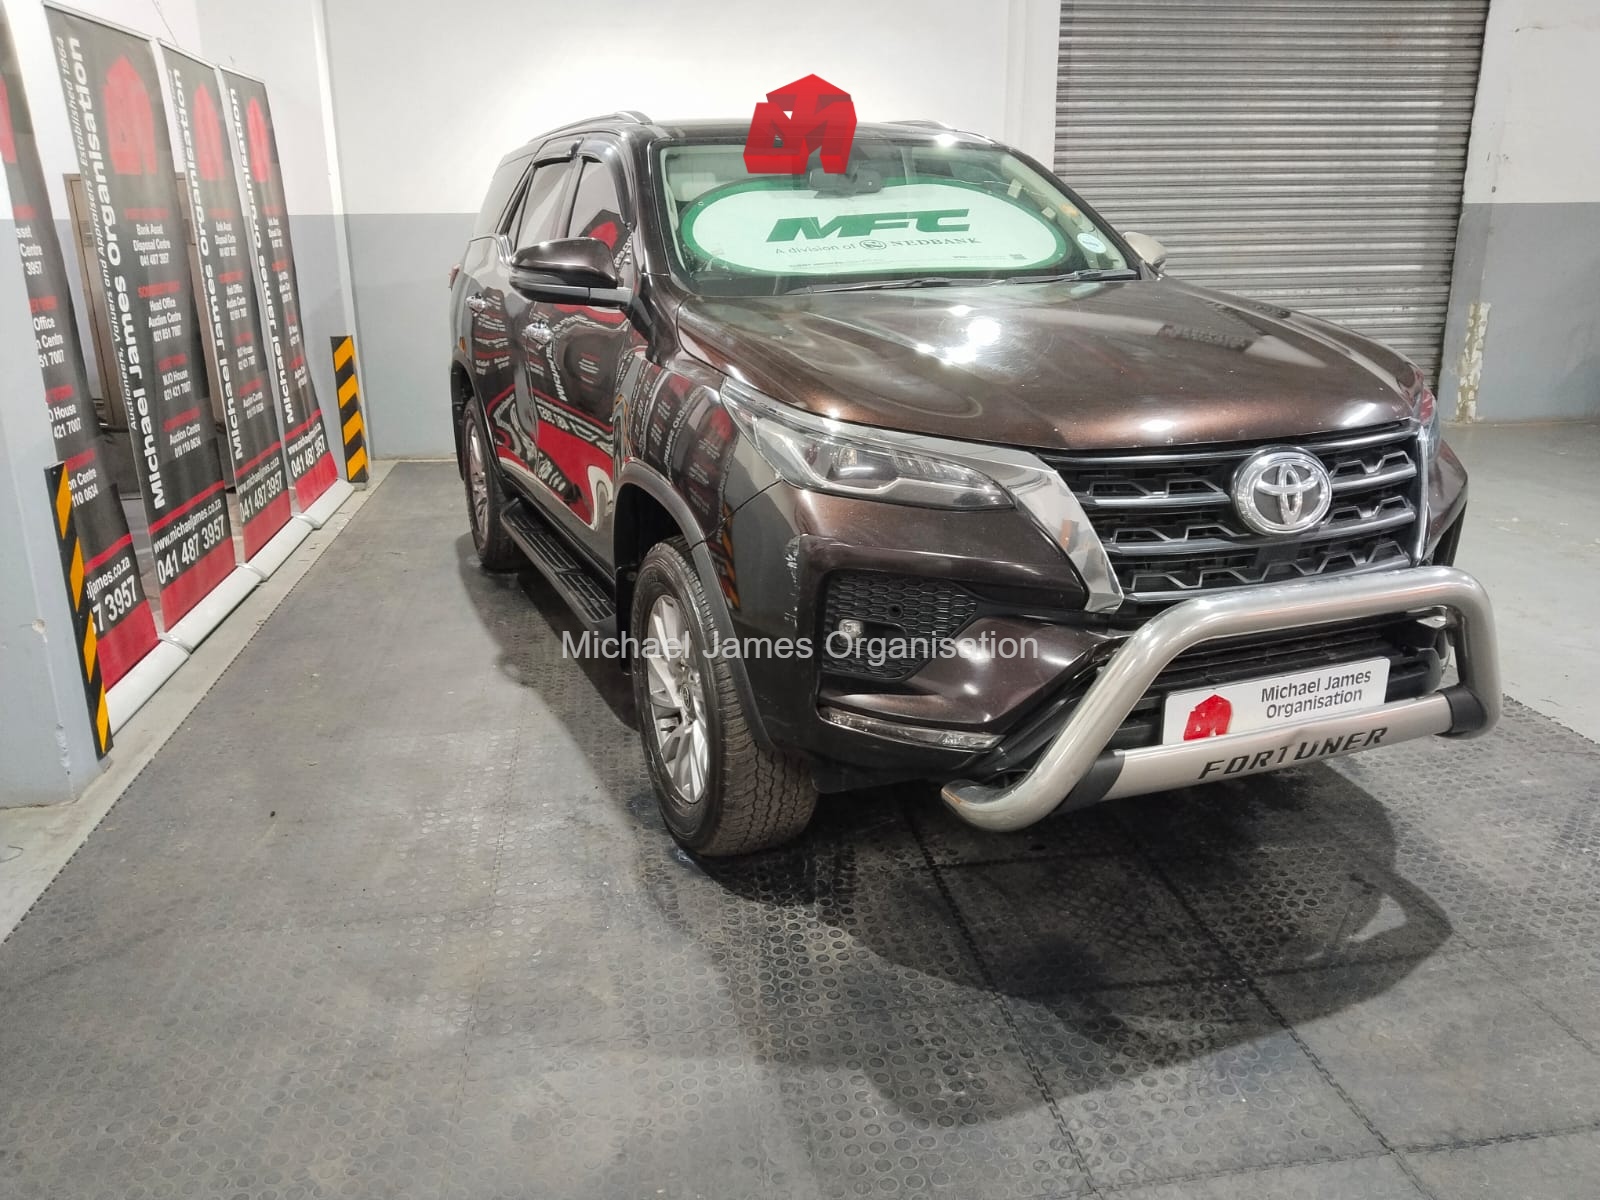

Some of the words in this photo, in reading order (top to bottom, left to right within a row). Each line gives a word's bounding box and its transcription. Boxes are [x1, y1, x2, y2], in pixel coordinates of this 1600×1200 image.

[67, 79, 88, 166] Established
[69, 37, 120, 266] Organisation
[172, 69, 209, 256] Organisation
[230, 88, 262, 248] Organisation
[16, 224, 32, 238] sset
[86, 179, 106, 257] Appraisers
[766, 208, 970, 242] MFC
[20, 243, 43, 257] Centre
[789, 244, 839, 254] division
[891, 238, 984, 247] NEDBANK
[101, 260, 112, 286] and
[258, 256, 276, 331] James
[33, 316, 56, 331] Office
[105, 291, 121, 342] Valuers
[115, 276, 142, 379] James
[205, 264, 225, 352] James
[42, 333, 64, 350] Centre
[272, 336, 294, 424] Michael
[54, 403, 77, 420] House
[54, 423, 66, 440] 421
[66, 417, 82, 434] 7007
[220, 358, 242, 460] Michael
[133, 388, 165, 510] Michael
[169, 430, 186, 446] Auction
[77, 467, 97, 486] Centre
[290, 455, 305, 478] 041
[72, 493, 83, 508] 110
[83, 483, 99, 502] 0634
[239, 495, 254, 523] 041
[254, 485, 267, 509] 487
[267, 470, 282, 499] 3957
[153, 498, 221, 554] www.michaeljames.co.za
[158, 548, 180, 584] 041
[181, 534, 200, 565] 487
[201, 514, 225, 550] 3957
[105, 574, 137, 621] 3957
[1261, 678, 1321, 702] Michael
[1324, 670, 1372, 691] James
[1266, 688, 1362, 719] Organisation
[1198, 727, 1388, 780] FORTUNER
